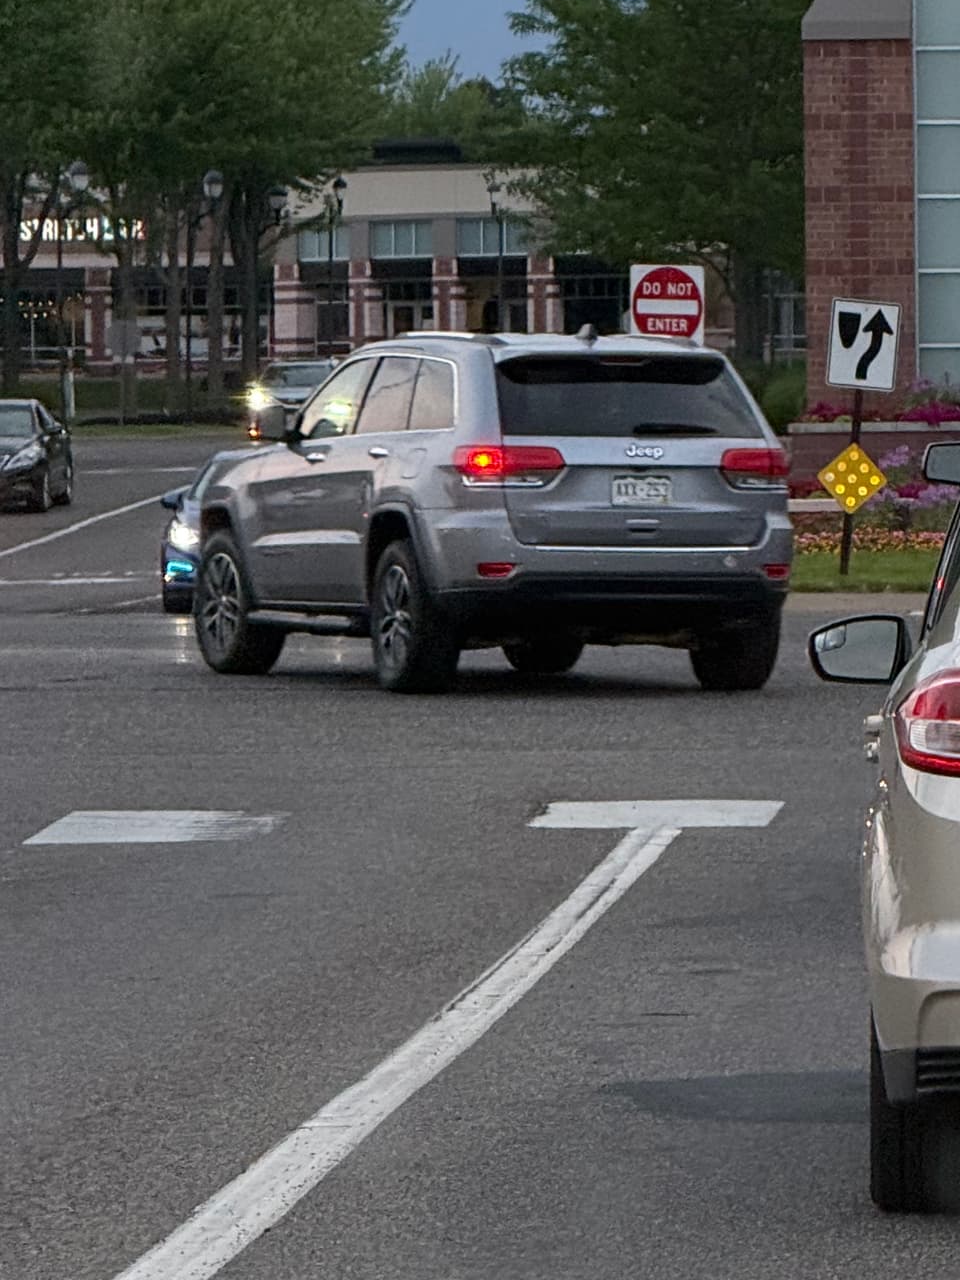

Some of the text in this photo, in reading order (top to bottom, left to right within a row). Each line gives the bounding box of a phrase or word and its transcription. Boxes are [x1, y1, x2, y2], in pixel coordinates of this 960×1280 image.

[642, 282, 693, 296] DO NOT
[647, 318, 688, 332] ENTER
[626, 444, 663, 459] Jeep
